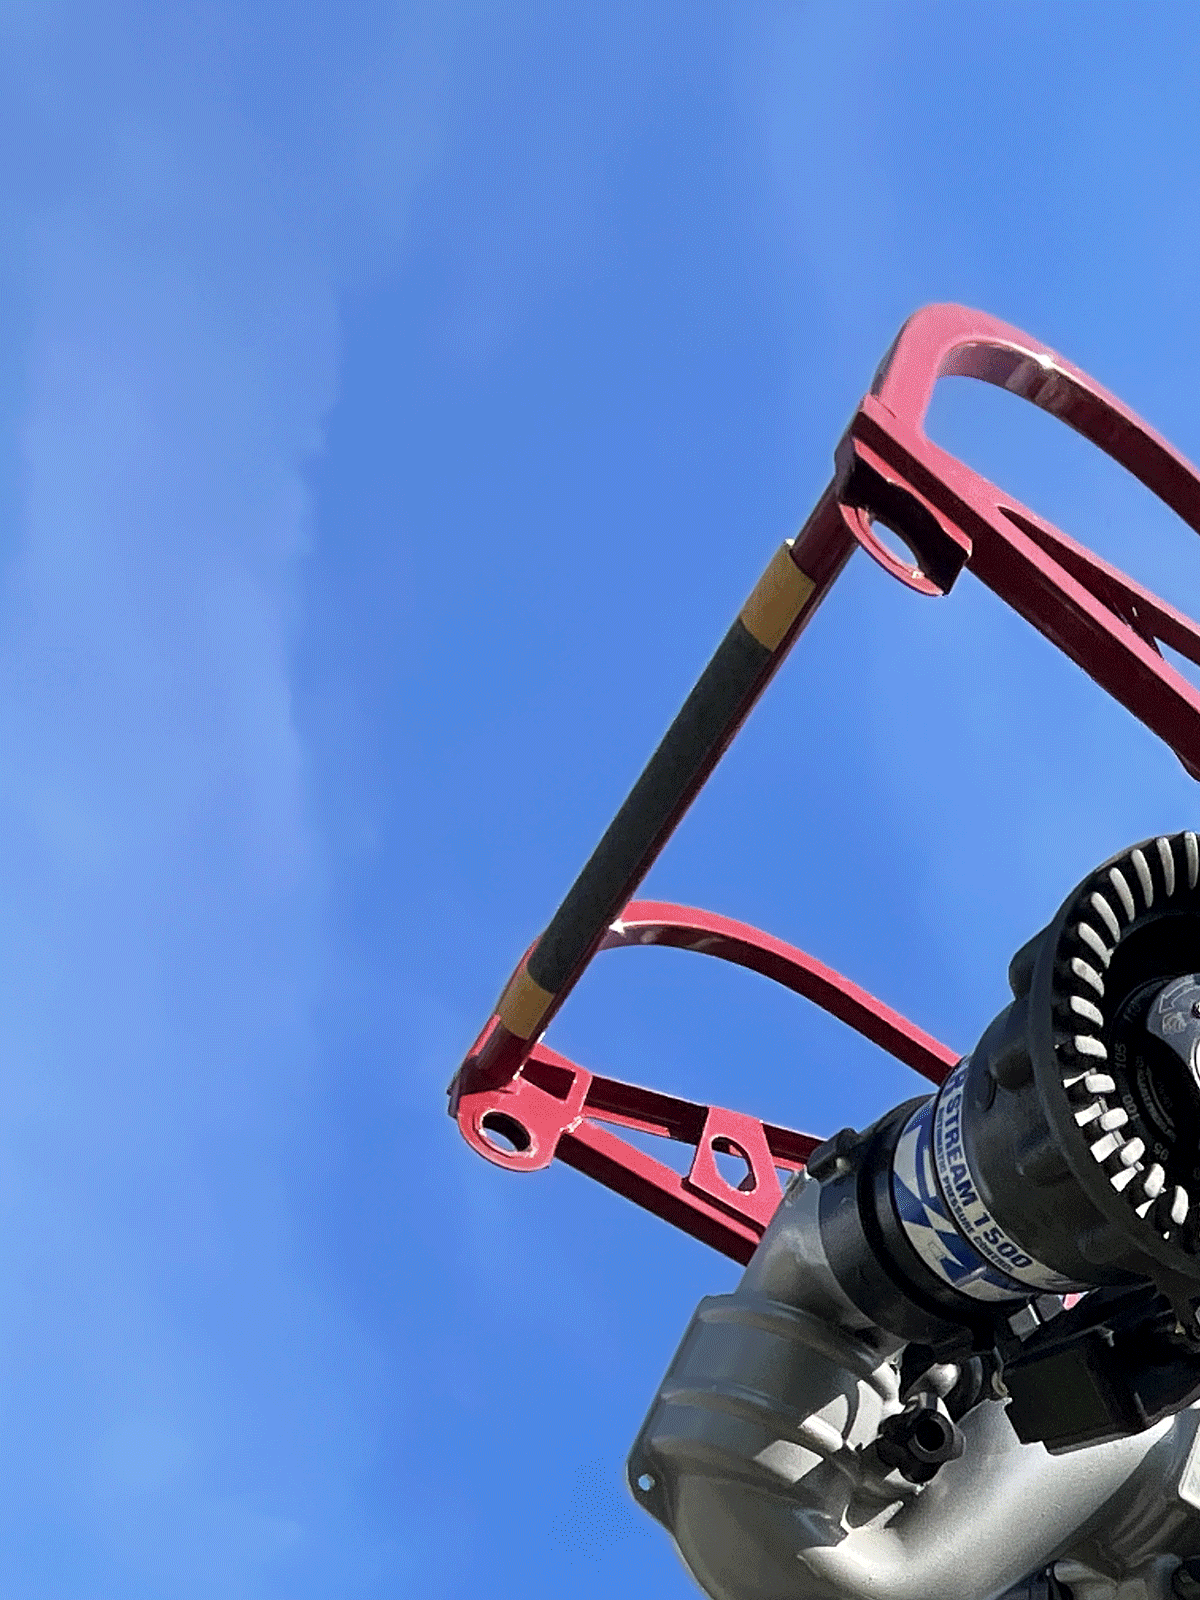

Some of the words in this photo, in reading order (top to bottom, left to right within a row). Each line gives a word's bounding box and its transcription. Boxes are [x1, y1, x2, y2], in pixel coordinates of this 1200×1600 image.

[1115, 1044, 1126, 1068] 105
[1122, 1094, 1140, 1120] 100
[942, 1174, 975, 1234] PRESSURE
[973, 1236, 1014, 1273] CONTROL
[974, 1212, 1033, 1268] 1500
